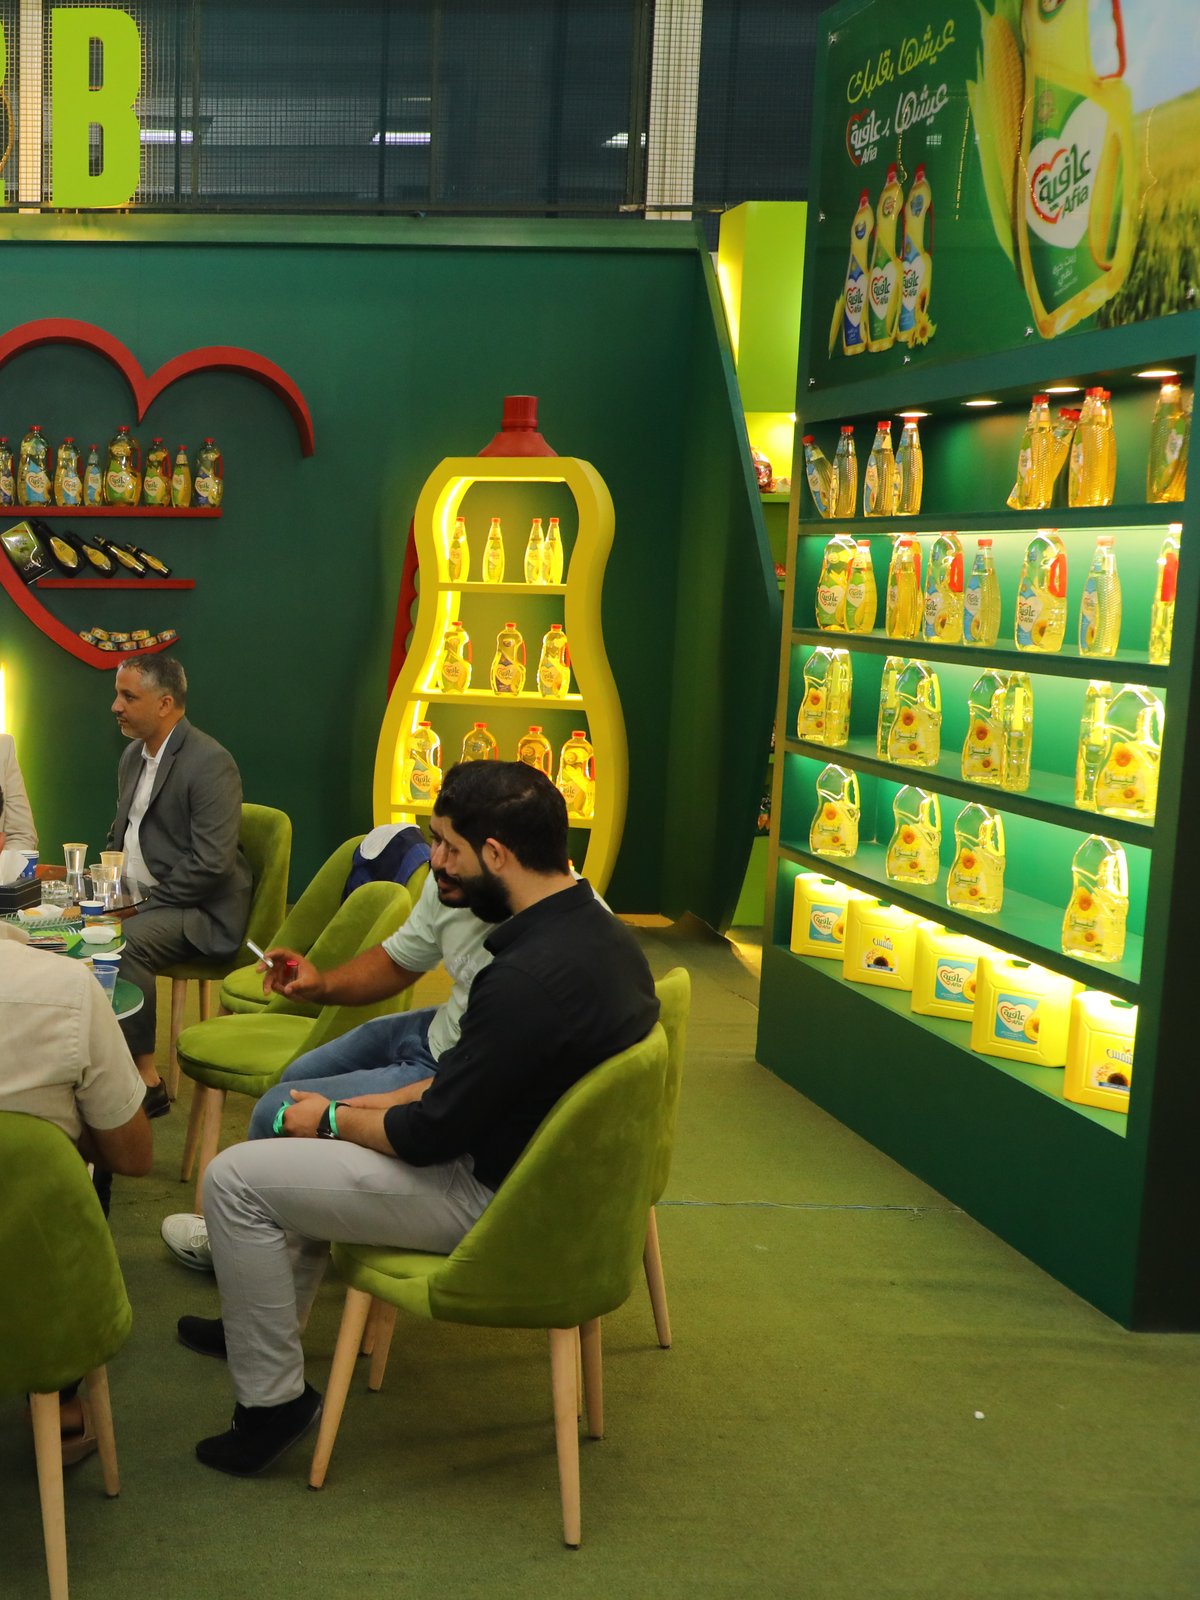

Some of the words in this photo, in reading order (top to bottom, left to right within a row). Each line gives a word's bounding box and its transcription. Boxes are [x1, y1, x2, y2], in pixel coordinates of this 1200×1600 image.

[851, 110, 881, 156] عافية
[860, 145, 878, 166] Afia
[1039, 143, 1091, 212] عافية
[1062, 185, 1089, 219] Afia
